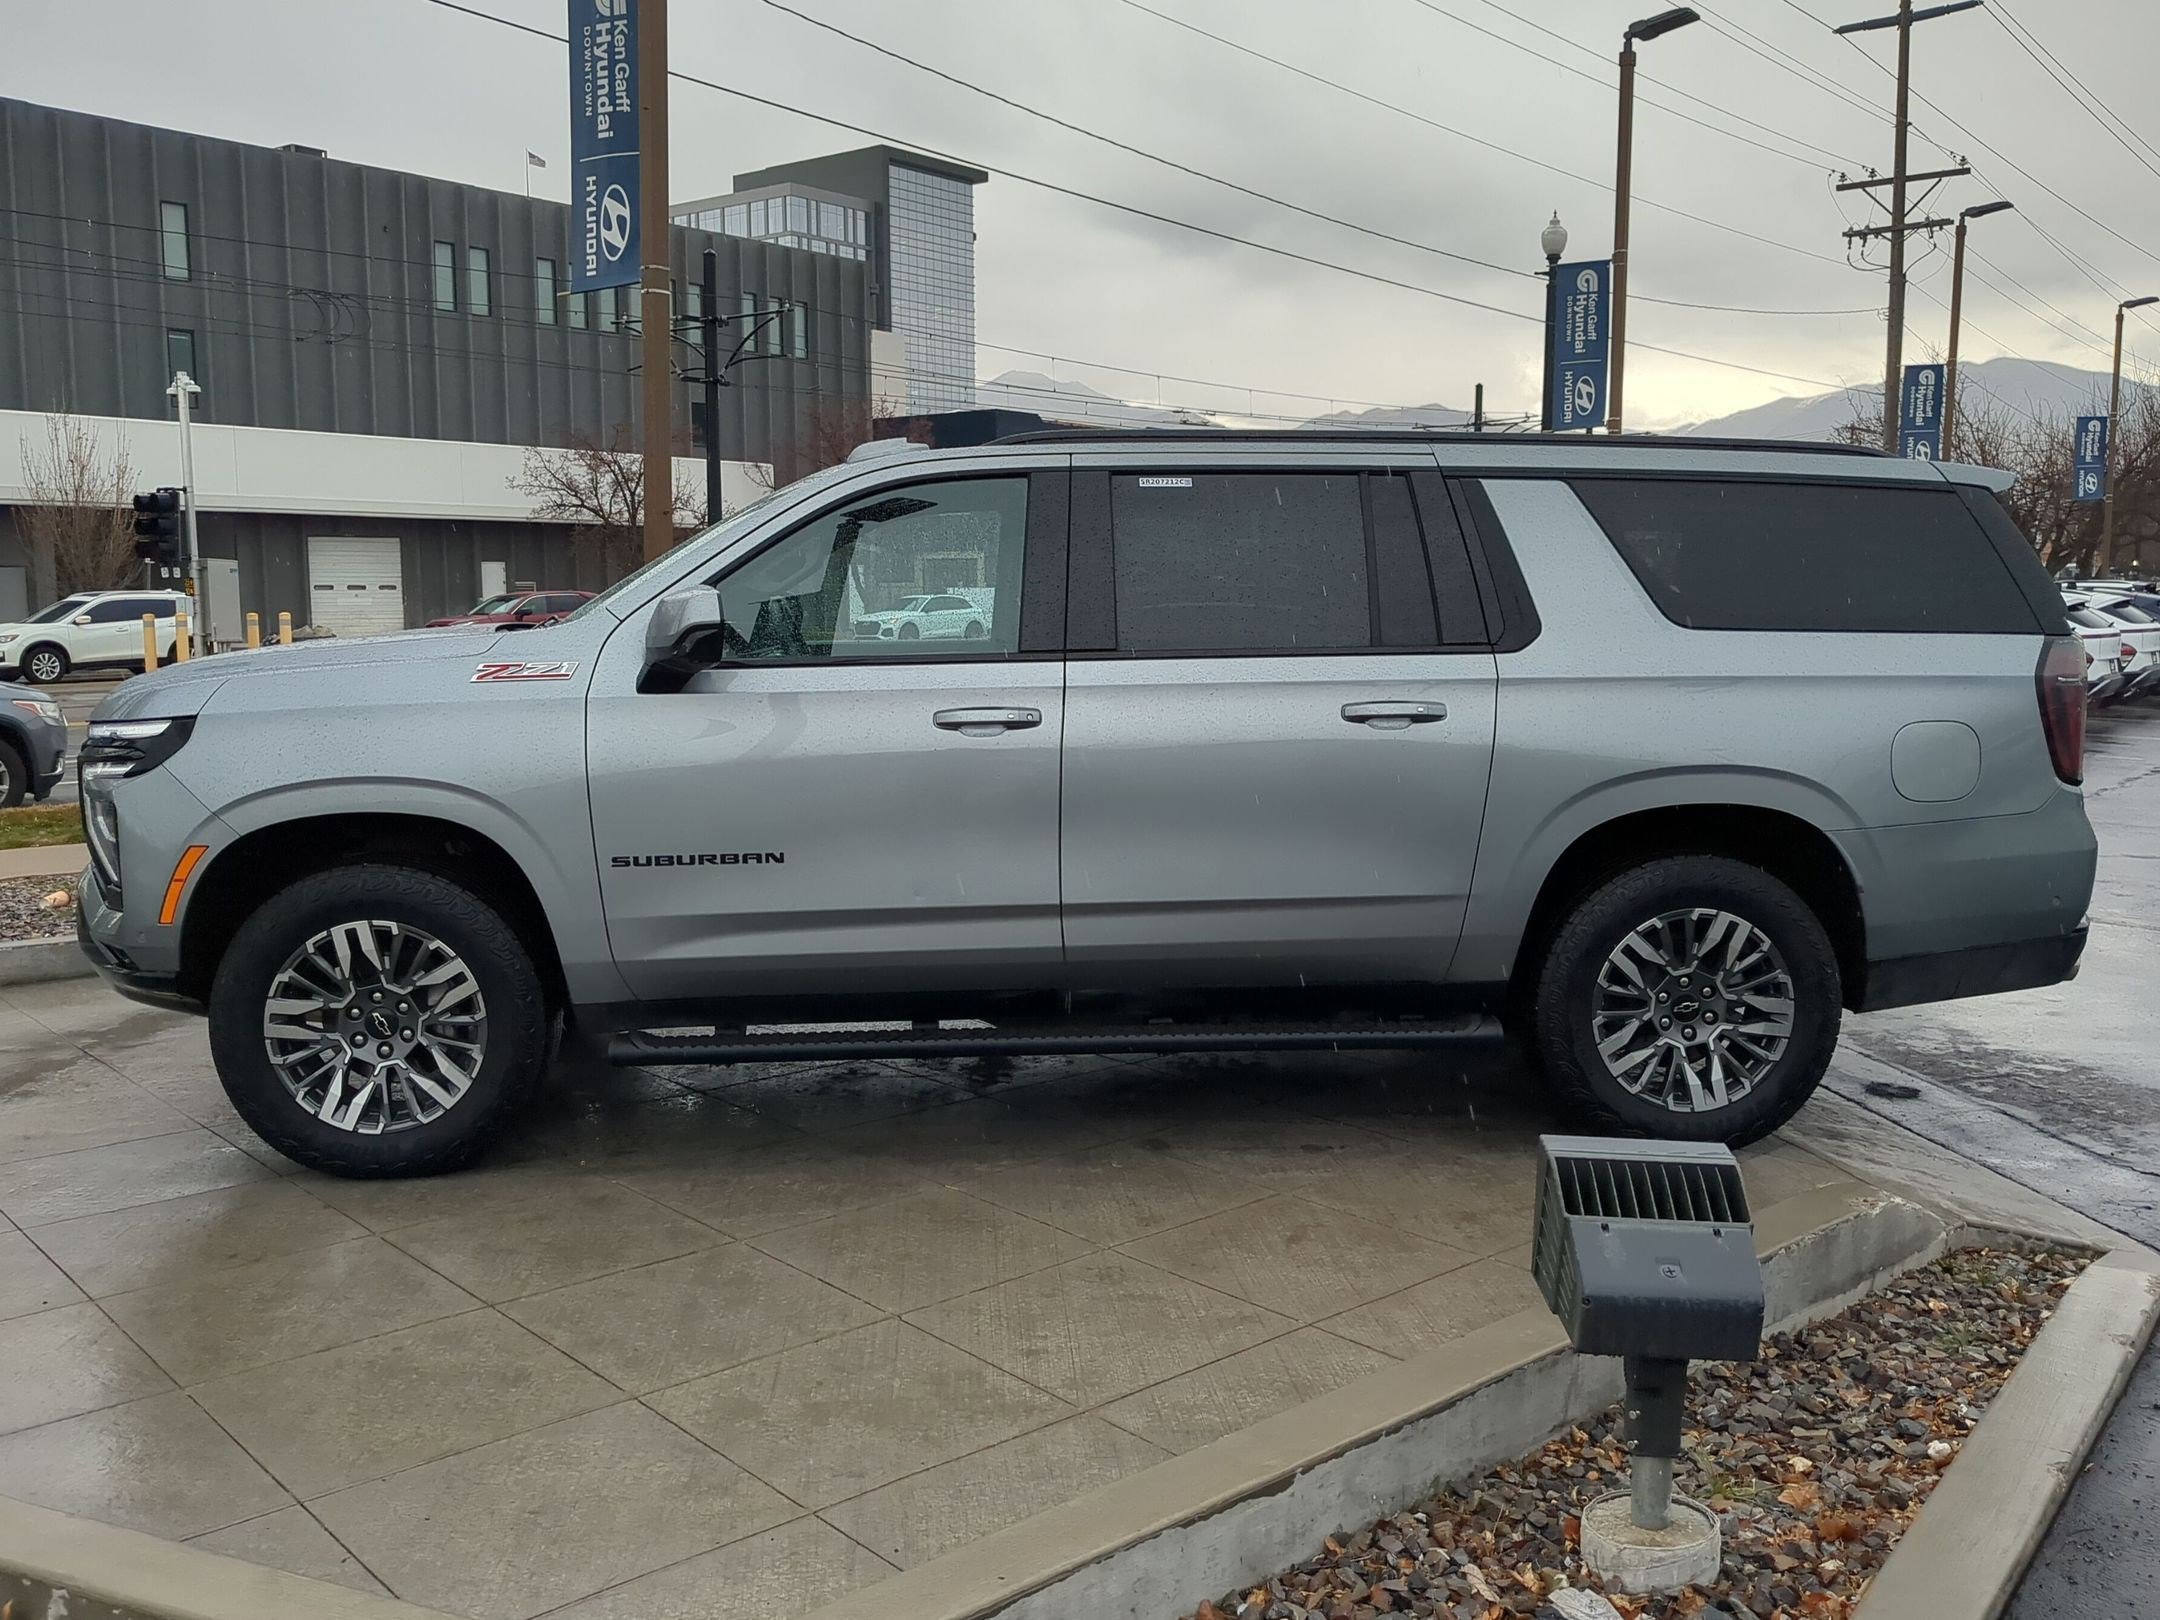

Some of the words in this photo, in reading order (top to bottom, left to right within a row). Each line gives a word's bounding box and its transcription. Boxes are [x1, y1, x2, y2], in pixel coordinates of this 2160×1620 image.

[613, 20, 628, 60] Ken
[584, 26, 592, 117] DOWNTOWN
[594, 22, 614, 139] Hyundai
[614, 62, 630, 113] Garff
[586, 175, 597, 277] HYUNDAI
[1574, 294, 1588, 354] Hyundai
[1587, 293, 1598, 315] Ken
[1587, 315, 1597, 341] Garff
[1563, 371, 1573, 423] HYUNDAI
[1915, 386, 1927, 426] Hyundai
[1907, 436, 1915, 459] HYUN
[470, 661, 579, 683] Z71
[611, 852, 785, 868] SUBURBAN
